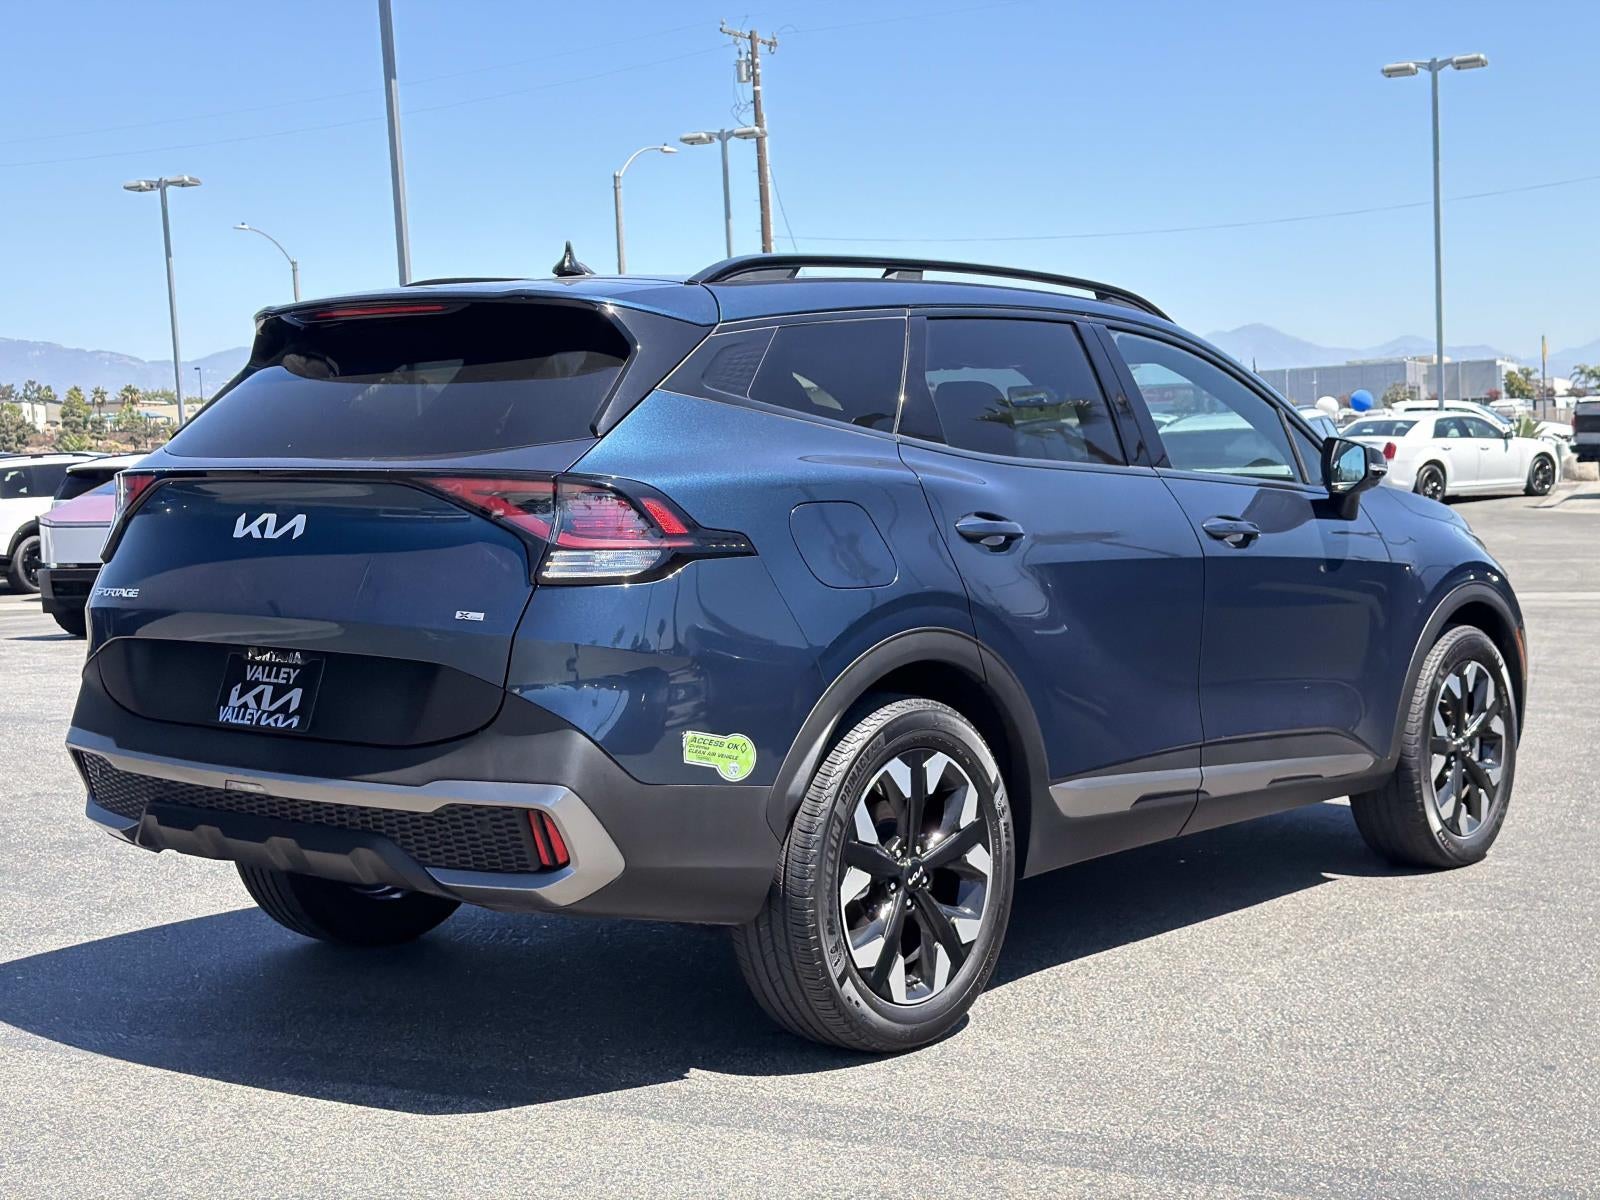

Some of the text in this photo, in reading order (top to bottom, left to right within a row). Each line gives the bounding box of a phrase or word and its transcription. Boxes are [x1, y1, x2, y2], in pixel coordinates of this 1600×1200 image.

[233, 512, 307, 540] KIA
[95, 587, 140, 598] SPORTAGE
[246, 665, 301, 685] VALLEY
[228, 682, 303, 714] KIA
[219, 706, 300, 729] VALLEY KIA
[691, 736, 725, 748] ACCESS
[727, 742, 740, 751] OK
